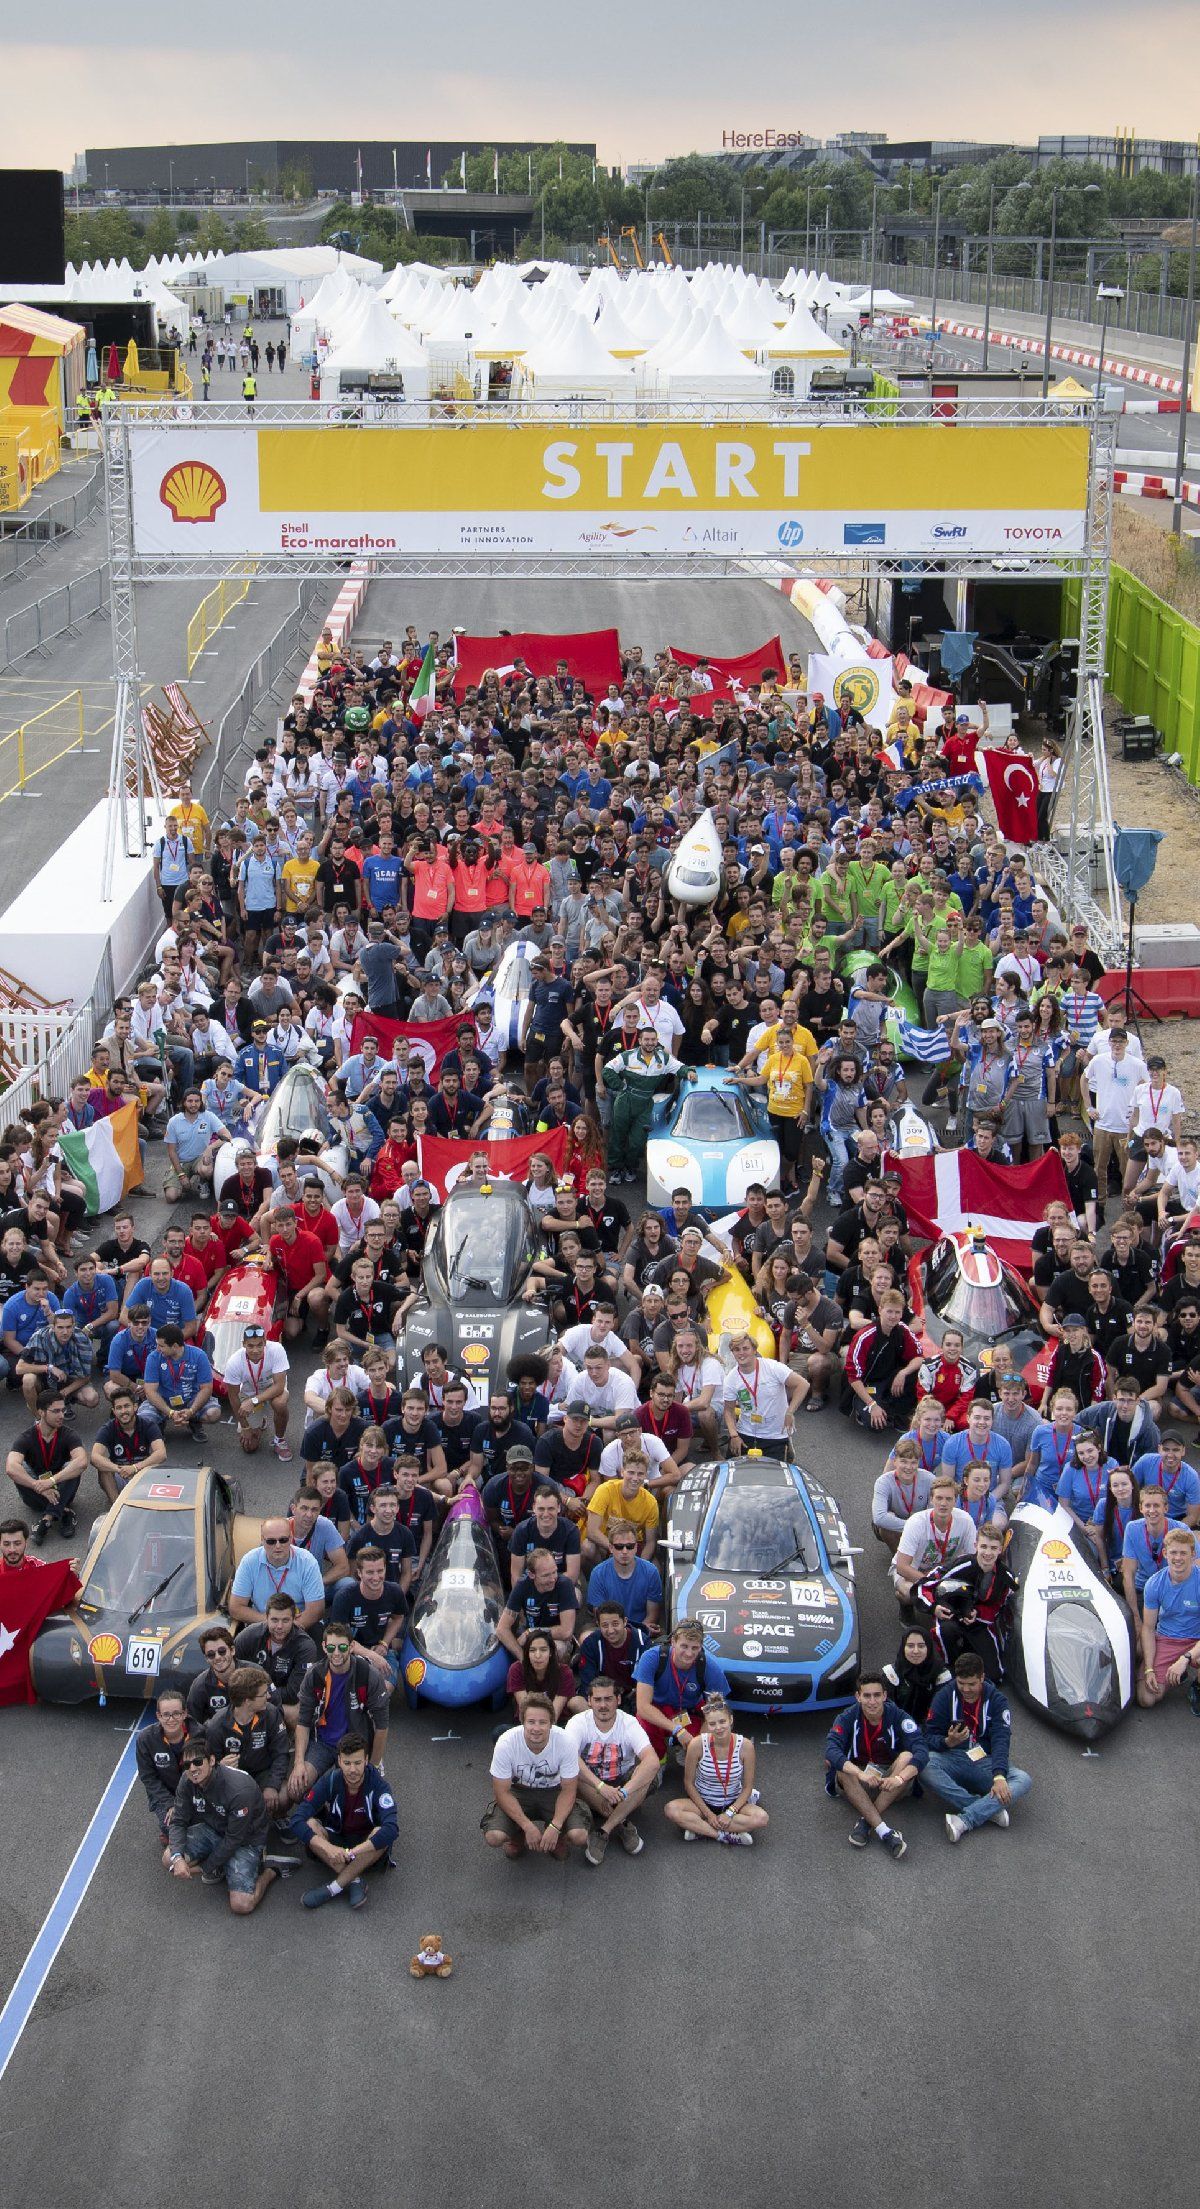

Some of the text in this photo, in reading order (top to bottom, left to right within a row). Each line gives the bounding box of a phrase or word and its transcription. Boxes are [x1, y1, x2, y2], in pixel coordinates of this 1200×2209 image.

[541, 441, 811, 499] START
[281, 523, 309, 533] Shell
[702, 527, 739, 542] Altair
[779, 523, 801, 546] hp
[933, 526, 968, 537] SwRI
[1003, 528, 1062, 539] TOYOTA
[281, 534, 396, 548] Eco-marathon
[578, 531, 607, 543] Agility
[449, 1574, 466, 1585] 33
[1048, 1570, 1074, 1582] 346
[795, 1588, 821, 1603] 702
[733, 1624, 795, 1637] dSPACE
[132, 1647, 155, 1668] 619
